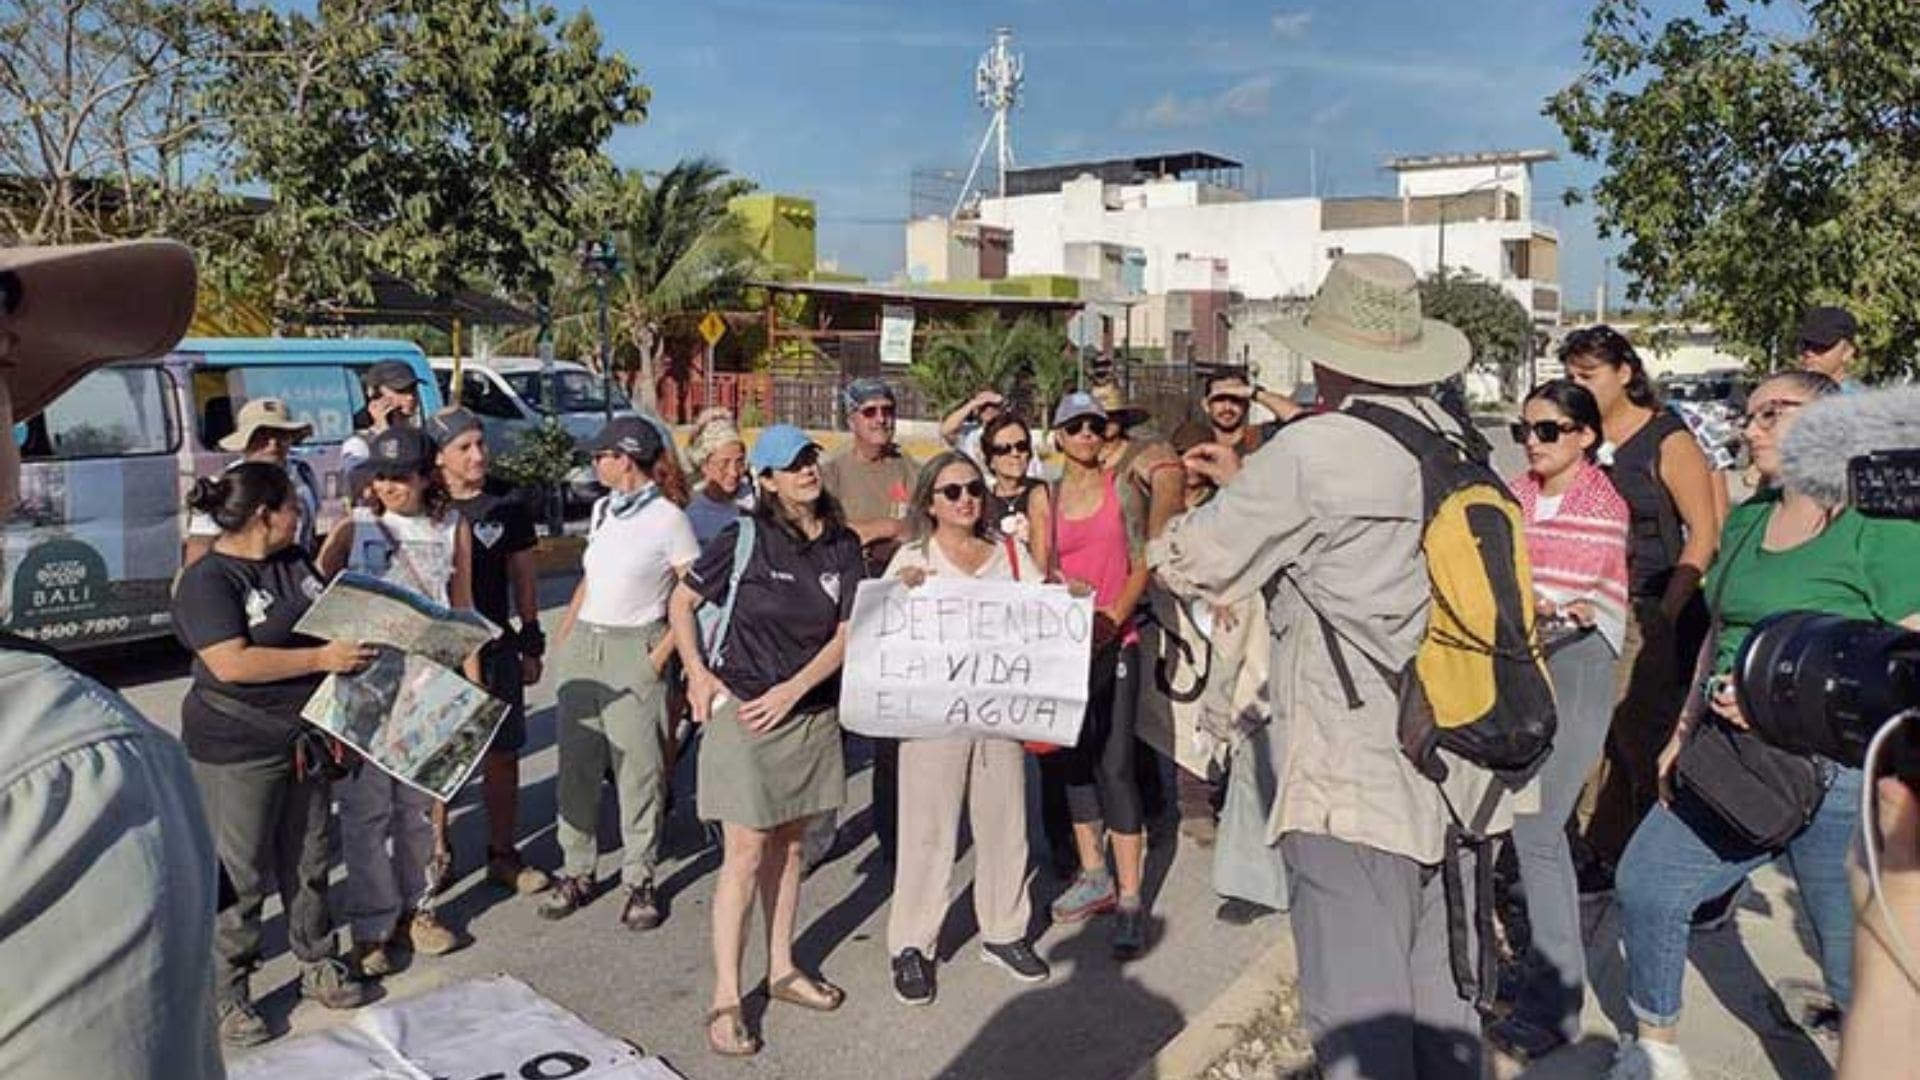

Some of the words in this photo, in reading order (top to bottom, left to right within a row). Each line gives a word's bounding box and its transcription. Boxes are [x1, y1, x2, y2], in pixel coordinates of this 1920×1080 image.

[32, 586, 91, 607] BALI
[875, 596, 1088, 644] DEFIENDO
[879, 651, 927, 681] LA
[946, 652, 1032, 686] VIDA
[875, 690, 922, 721] EL
[945, 694, 1059, 730] AGUA
